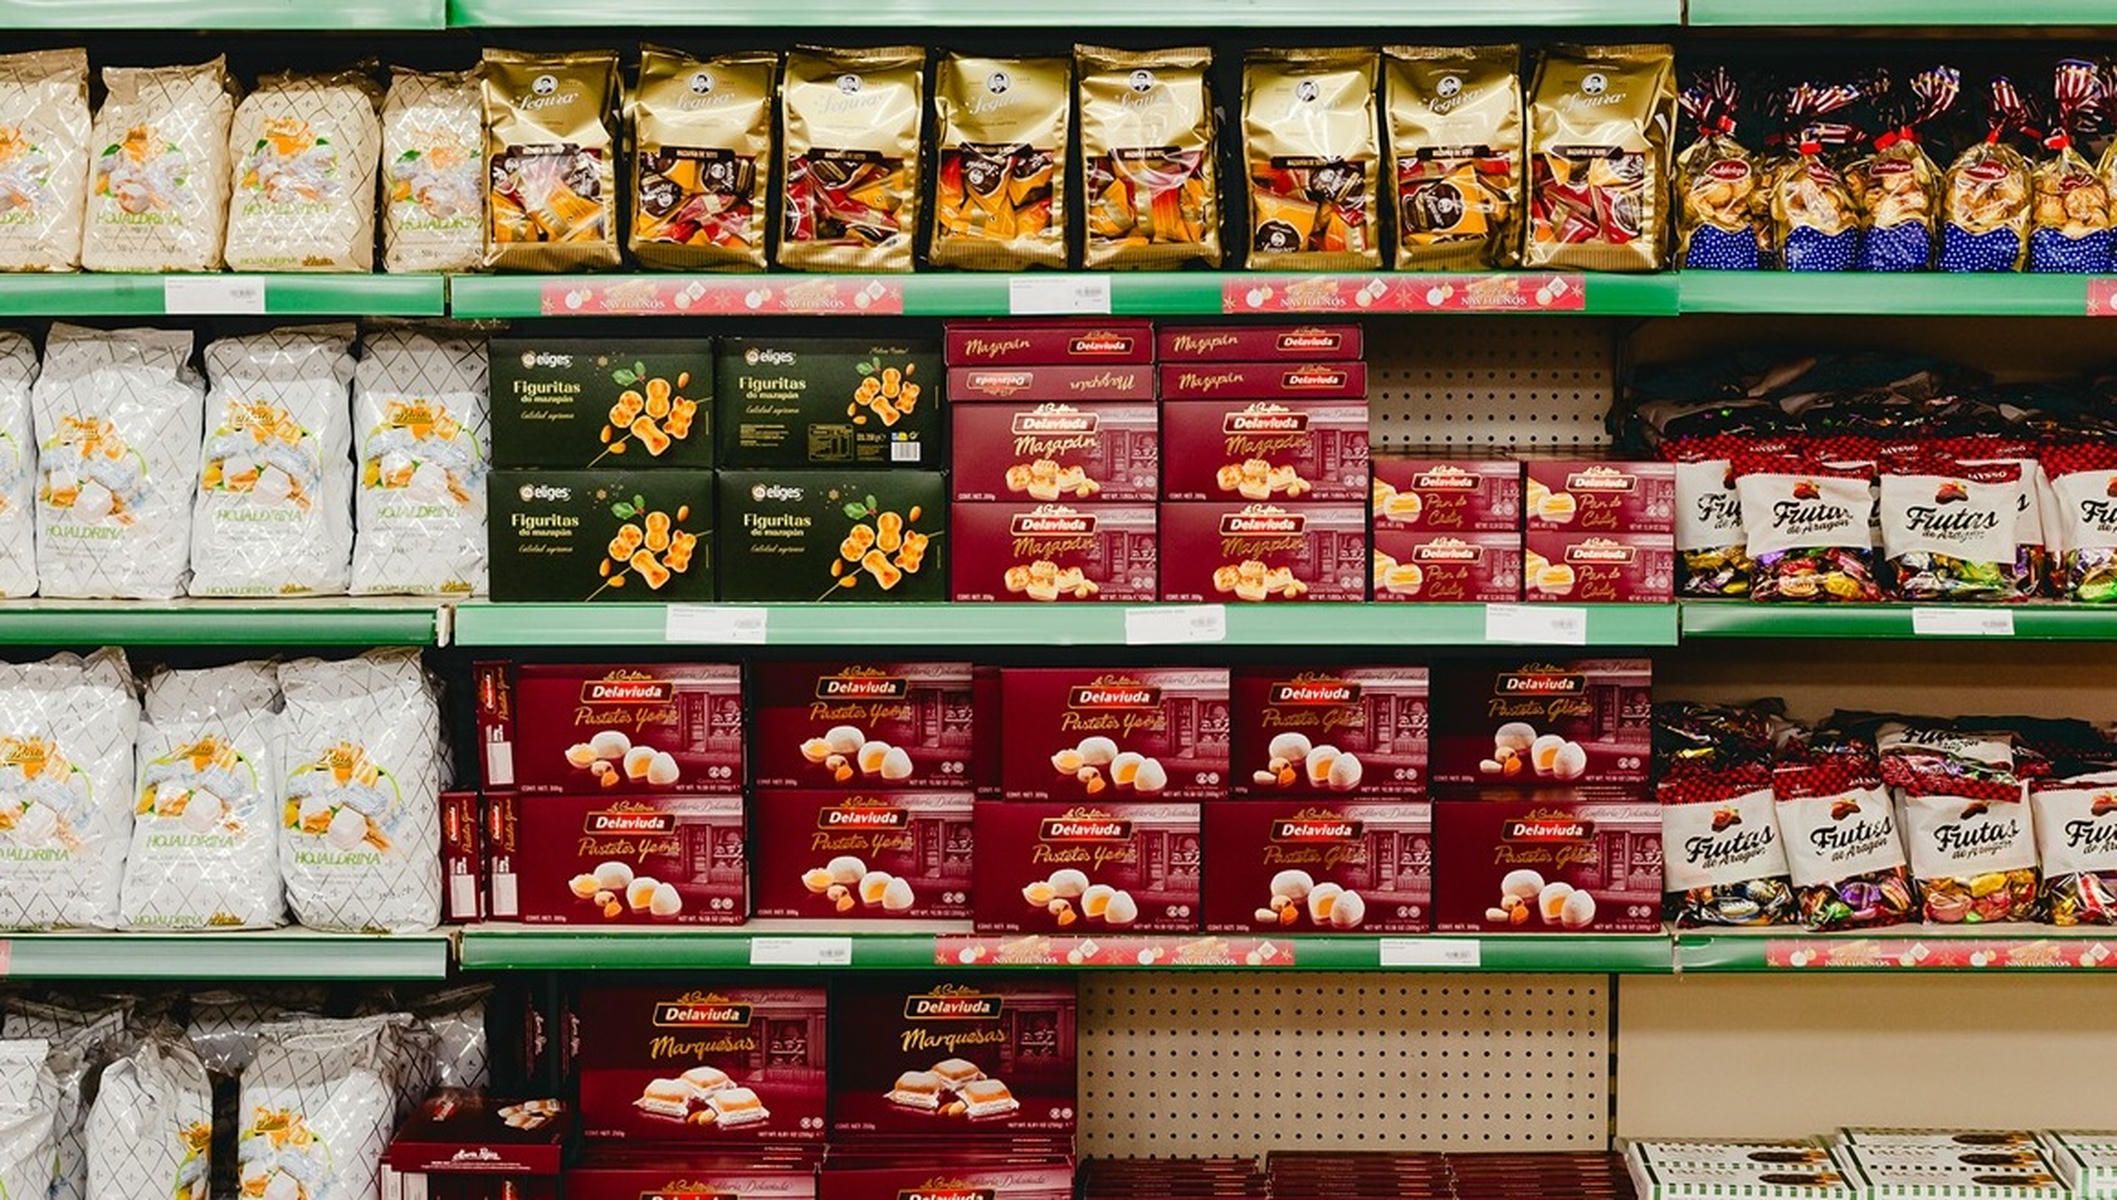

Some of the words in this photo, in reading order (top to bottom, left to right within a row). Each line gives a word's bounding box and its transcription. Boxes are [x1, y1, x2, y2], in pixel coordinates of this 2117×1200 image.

[965, 338, 1030, 358] Mazapán
[1075, 340, 1126, 351] Delaviuda
[1173, 334, 1238, 354] Mazapán
[1283, 336, 1333, 347] Delaviuda
[536, 351, 573, 369] eliges
[759, 349, 797, 366] eliges
[513, 380, 581, 395] Figuritas
[739, 376, 807, 392] Figuritas
[1179, 371, 1244, 392] Mazapán
[1289, 375, 1338, 386] Delaviuda
[520, 395, 532, 403] de
[533, 395, 574, 404] mazapán
[746, 391, 757, 399] de
[759, 392, 799, 401] mazapán
[1022, 417, 1089, 430] Delaviuda
[1234, 417, 1299, 429] Delaviuda
[1013, 434, 1099, 458] Mazapán
[1224, 434, 1311, 458] Mazapán
[1420, 477, 1473, 487] Delaviuda
[1575, 477, 1628, 488] Delaviuda
[534, 484, 572, 501] eliges
[766, 485, 804, 501] eliges
[511, 513, 579, 529] Figuritas
[743, 513, 812, 529] Figuritas
[1773, 500, 1854, 528] Frutas
[1906, 506, 1999, 531] Frutas
[1021, 518, 1087, 531] Delaviuda
[1230, 518, 1295, 531] Delaviuda
[518, 528, 530, 536] de
[530, 529, 573, 539] mazapán
[751, 528, 762, 536] de
[763, 529, 804, 539] mazapán
[1012, 536, 1096, 560] Mazapán
[1219, 536, 1304, 560] Mazapán
[1421, 548, 1474, 559] Delaviuda
[1573, 549, 1627, 559] Delaviuda
[827, 680, 896, 693] Delaviuda
[1506, 678, 1575, 690] Delaviuda
[592, 685, 663, 698] Delaviuda
[1079, 690, 1150, 704] Delaviuda
[1280, 687, 1350, 700] Delaviuda
[595, 816, 666, 829] Delaviuda
[829, 811, 898, 824] Delaviuda
[1051, 823, 1121, 836] Delaviuda
[1282, 823, 1352, 837] Delaviuda
[1513, 823, 1584, 837] Delaviuda
[1810, 816, 1893, 856] Frutas
[1933, 819, 2021, 852] Frutas
[1685, 825, 1775, 864] Frutas
[294, 850, 381, 865] HOJALDRINA
[665, 1007, 740, 1021] Delaviuda
[916, 1001, 990, 1014] Delaviuda
[650, 1035, 757, 1060] Marquesas
[901, 1028, 1007, 1053] Marquesas
